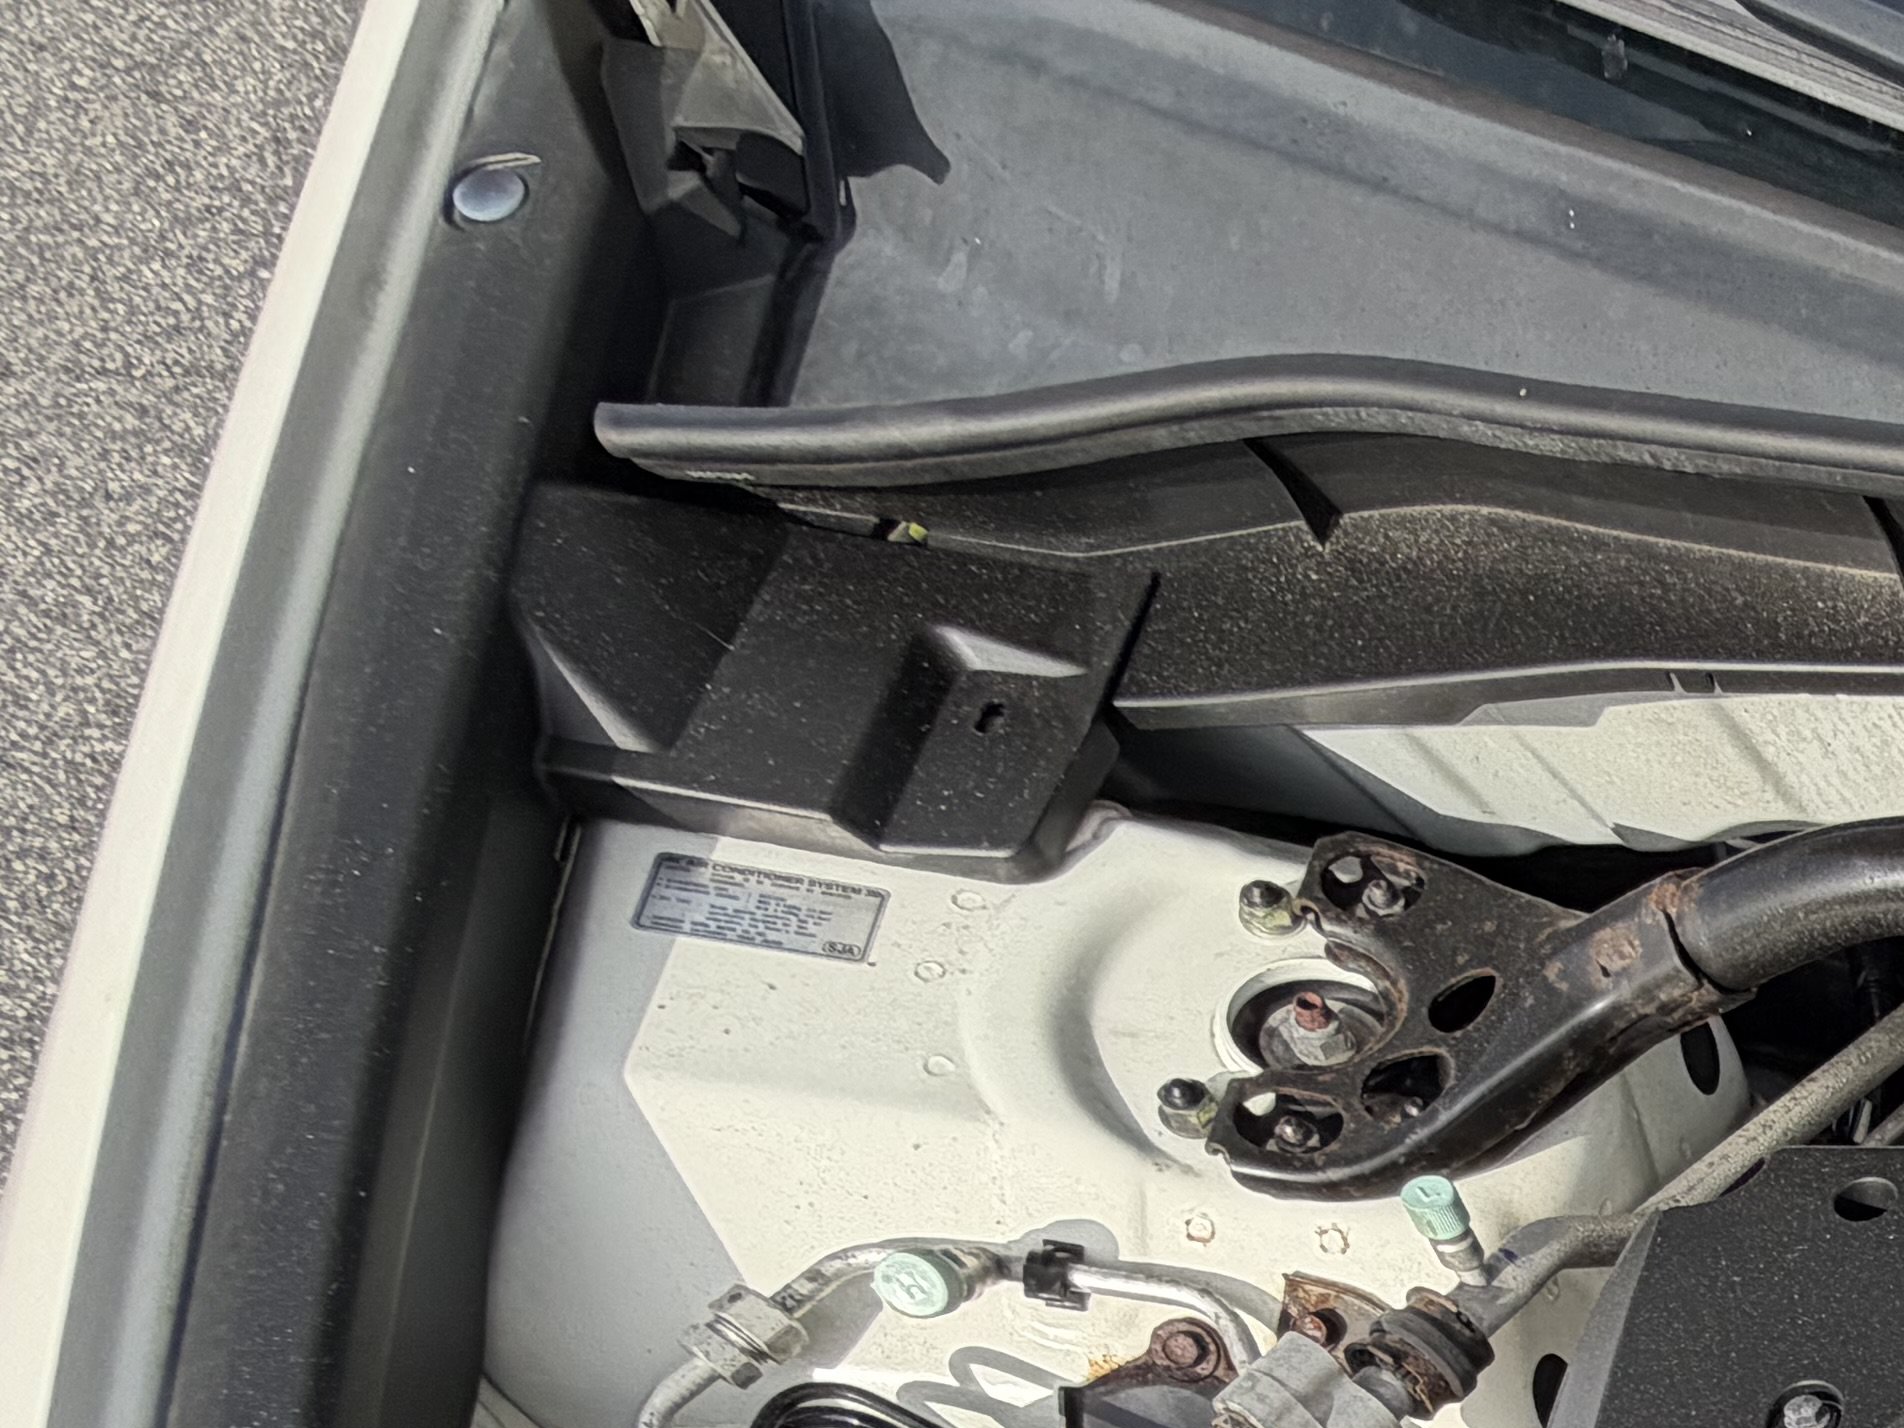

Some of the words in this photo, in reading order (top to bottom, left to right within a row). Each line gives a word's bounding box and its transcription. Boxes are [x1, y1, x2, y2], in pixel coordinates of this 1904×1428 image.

[711, 863, 804, 886] CONDITIONER
[808, 880, 863, 896] SYSTEM
[826, 942, 856, 956] SJA
